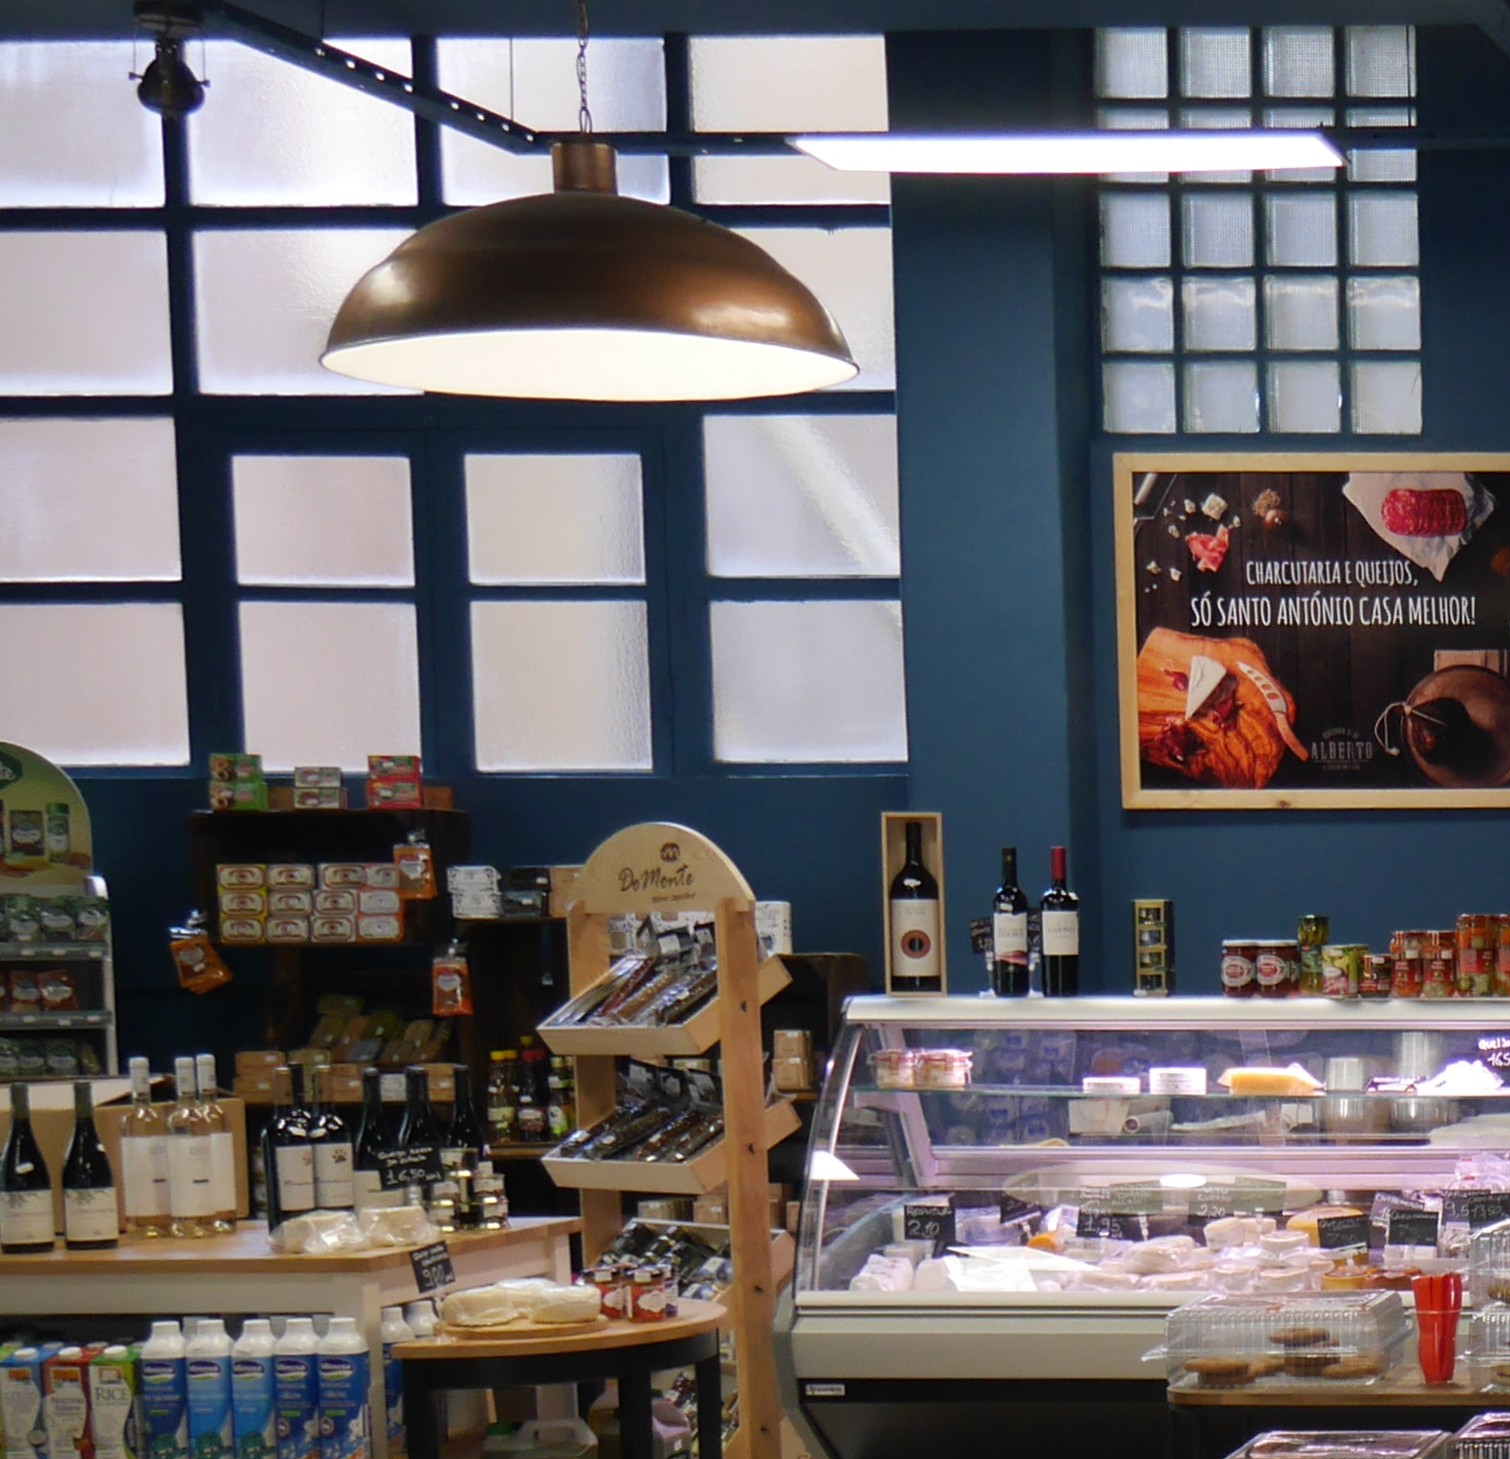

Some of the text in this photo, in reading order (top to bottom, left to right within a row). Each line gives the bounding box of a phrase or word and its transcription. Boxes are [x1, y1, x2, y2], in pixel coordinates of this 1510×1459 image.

[1246, 560, 1419, 587] CHARCUTARIA E QUEIJOS,
[1191, 591, 1476, 627] SÓ SANTO ANTÓNIO CASA MELHOR!
[1311, 741, 1373, 759] ALBERTO
